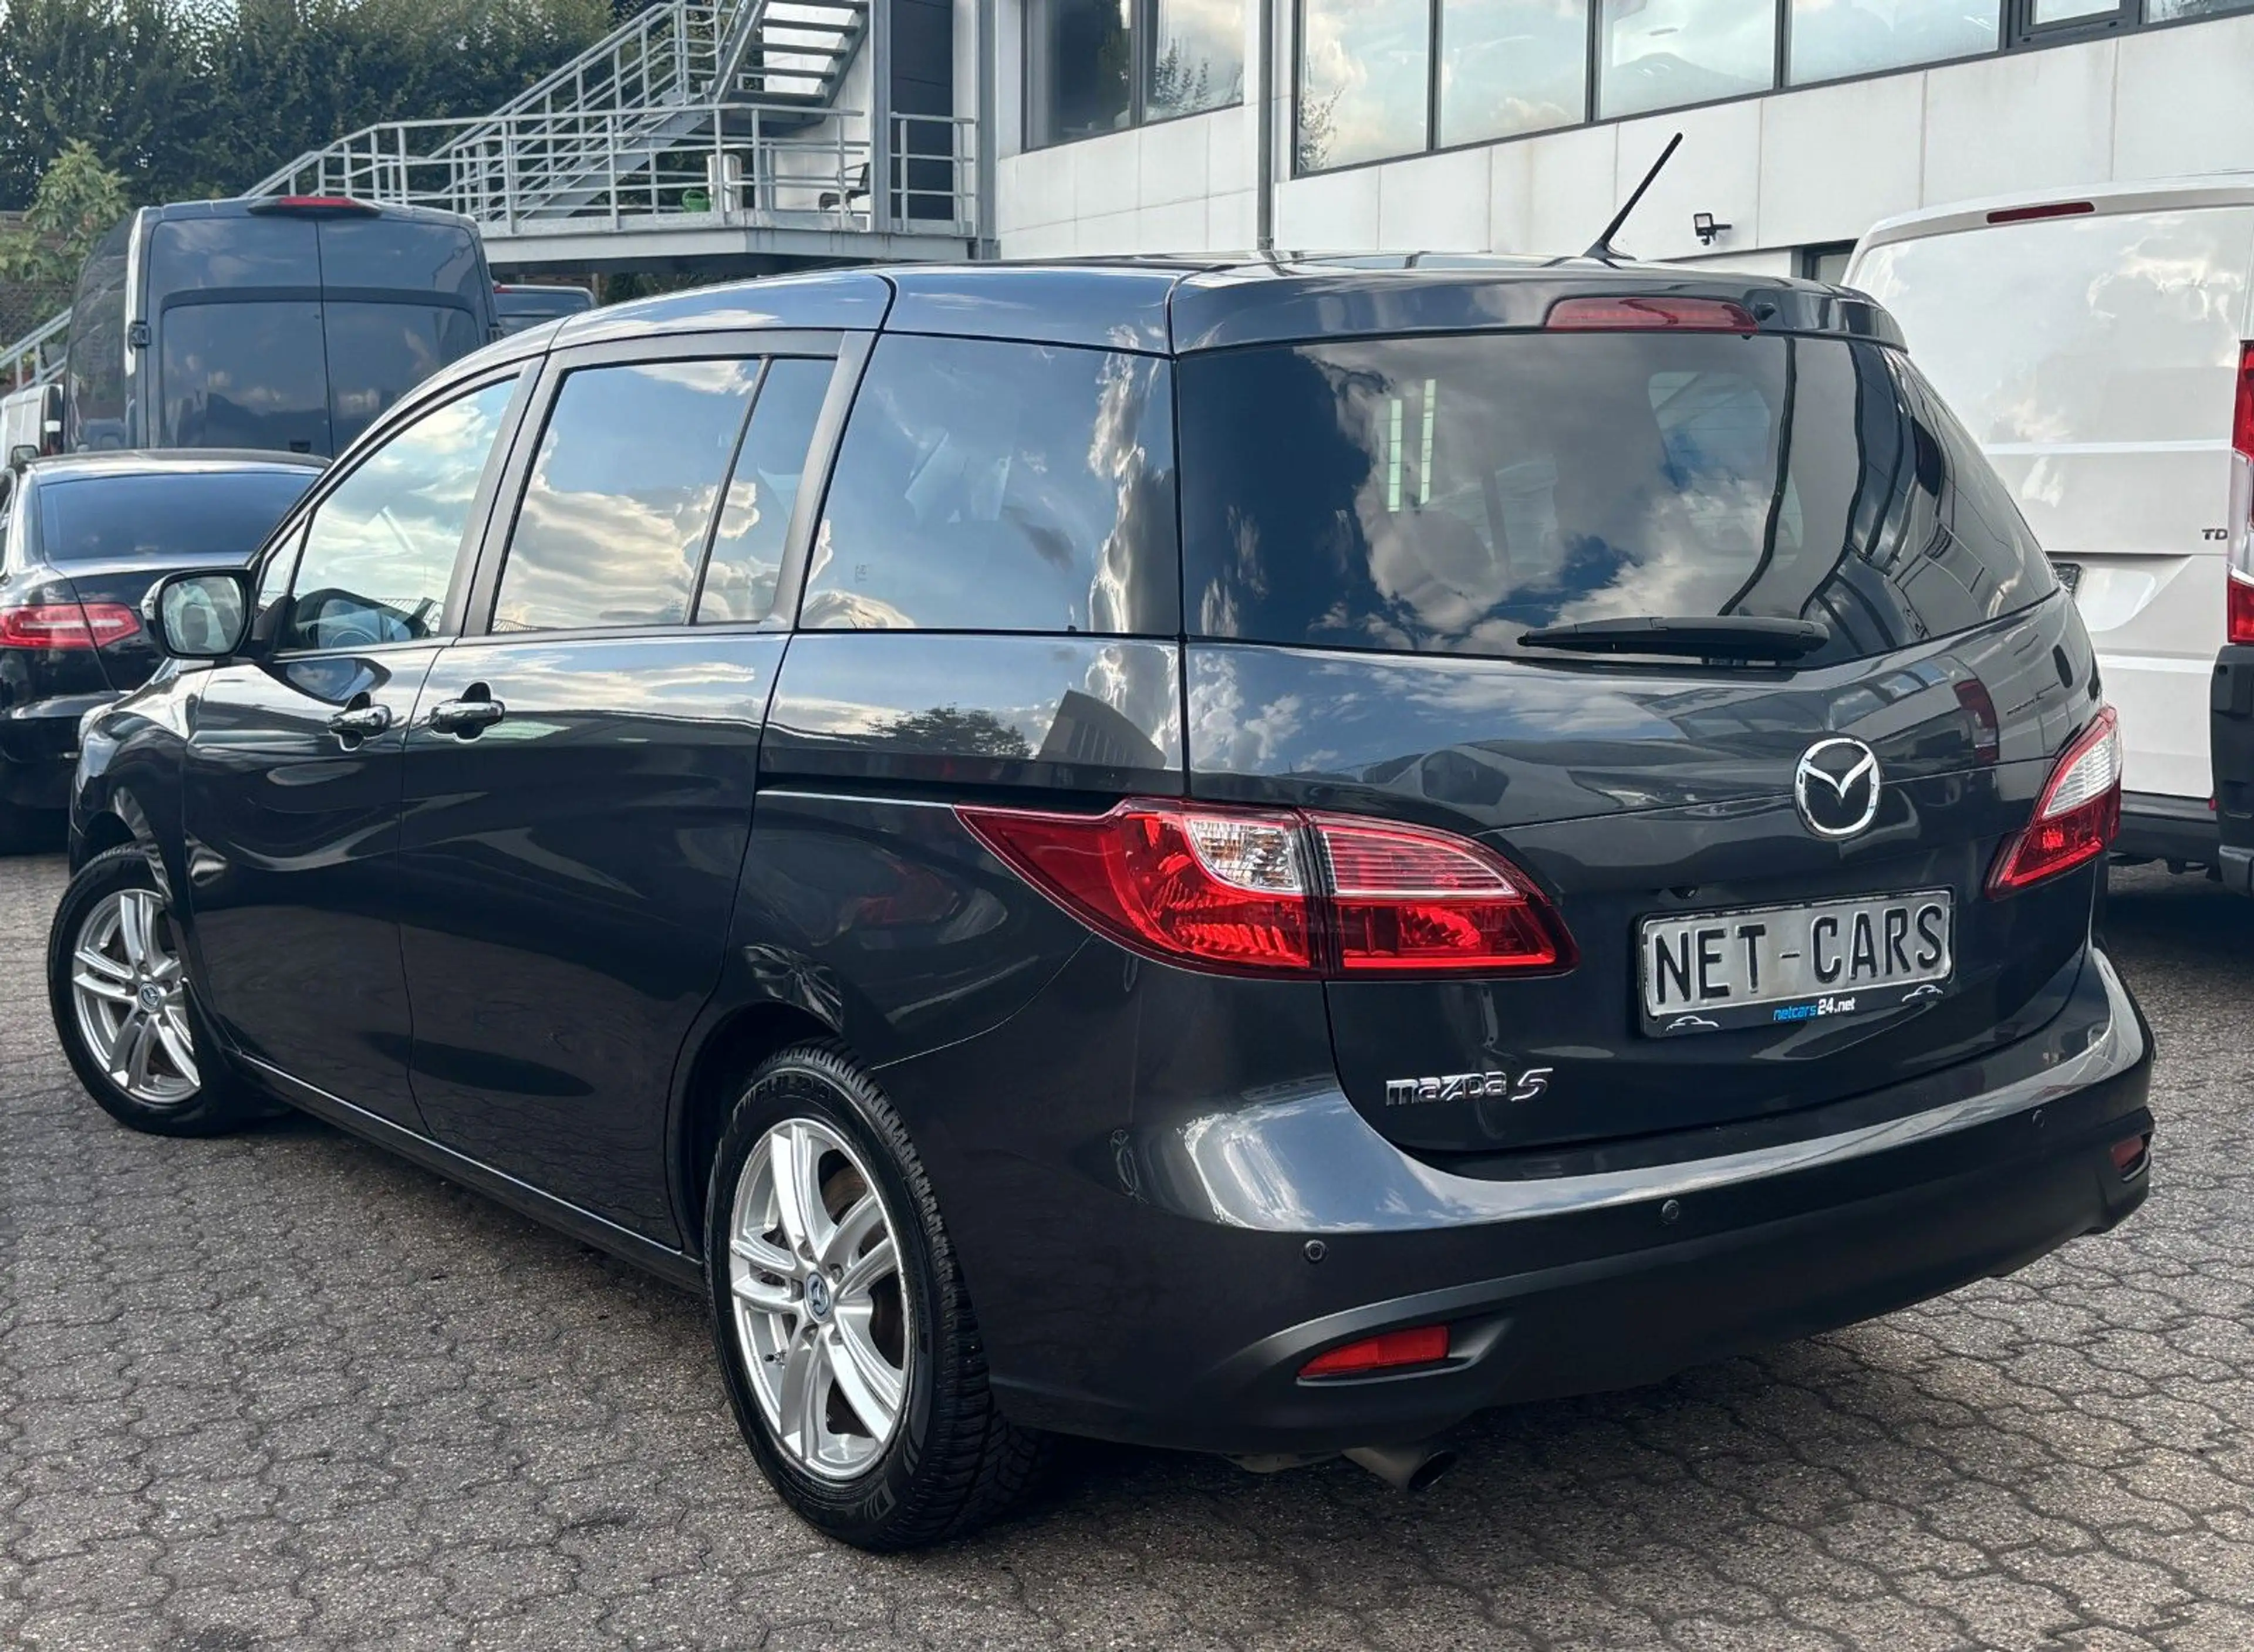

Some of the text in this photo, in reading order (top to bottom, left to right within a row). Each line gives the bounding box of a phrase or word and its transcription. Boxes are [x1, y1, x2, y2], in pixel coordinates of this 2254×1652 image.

[1773, 996, 1857, 1021] netcars24.net
[1385, 1067, 1554, 1106] mazda 5
